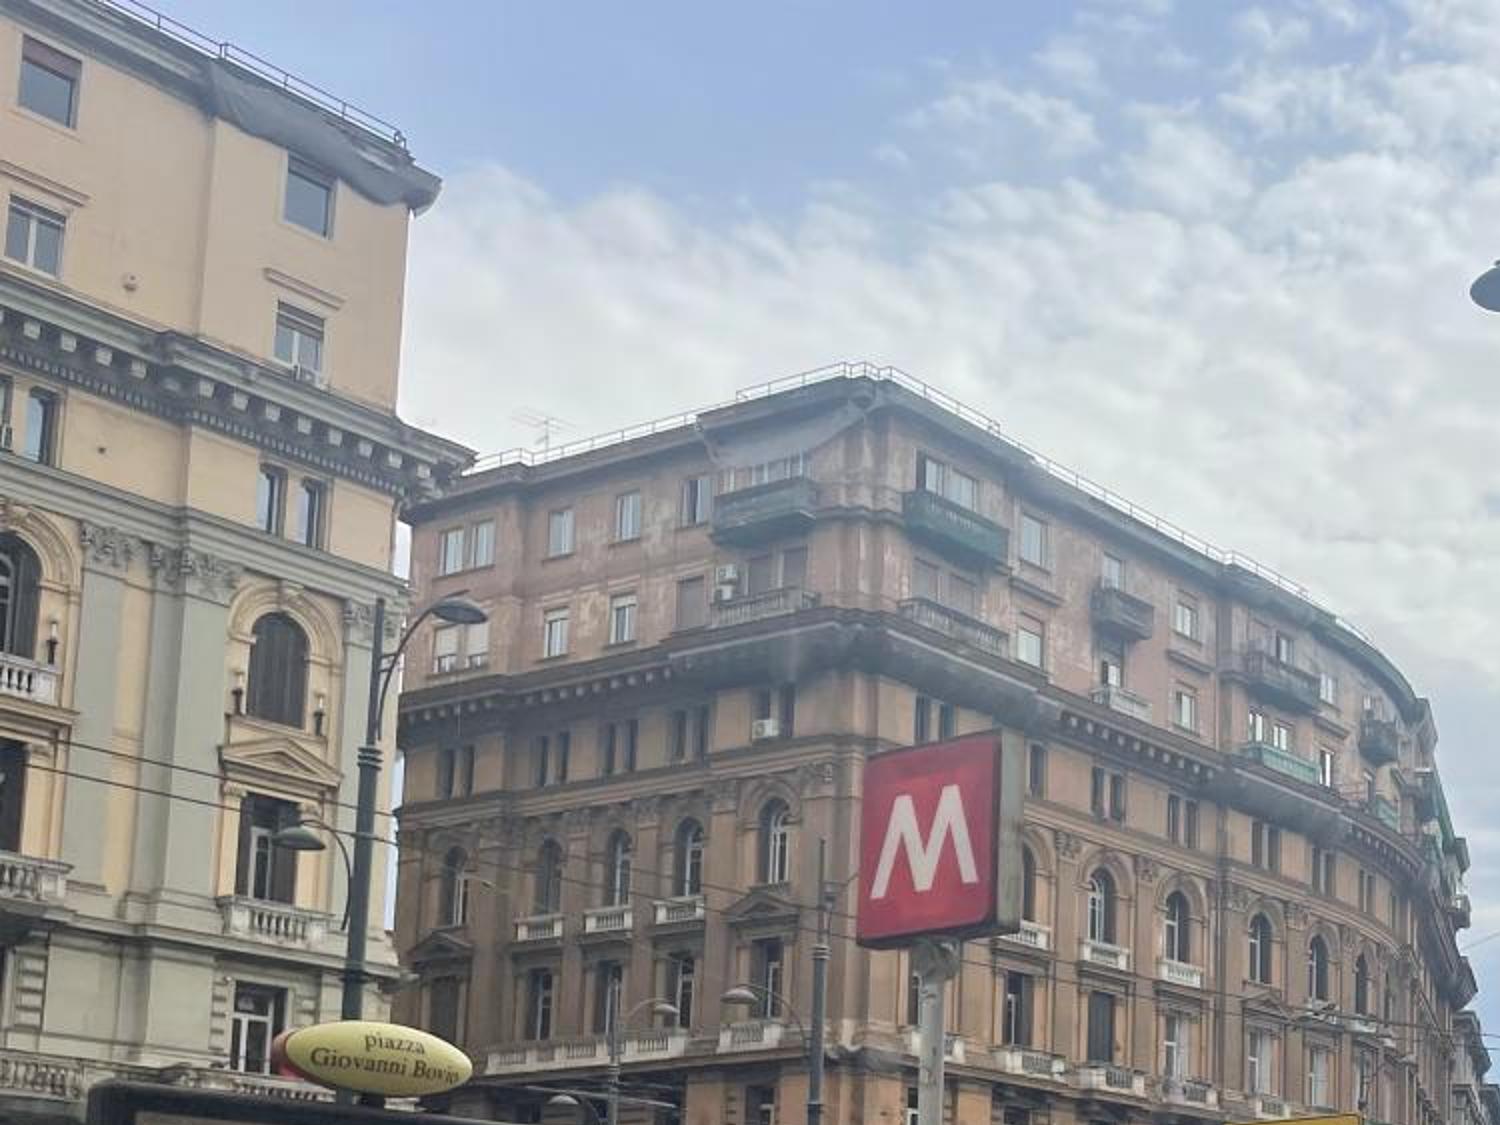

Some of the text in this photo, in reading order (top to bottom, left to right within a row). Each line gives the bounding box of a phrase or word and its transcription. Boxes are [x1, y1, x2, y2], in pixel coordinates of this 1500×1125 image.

[870, 784, 980, 900] M
[365, 1031, 425, 1053] piazza
[310, 1047, 460, 1084] Giovanni Bovio
